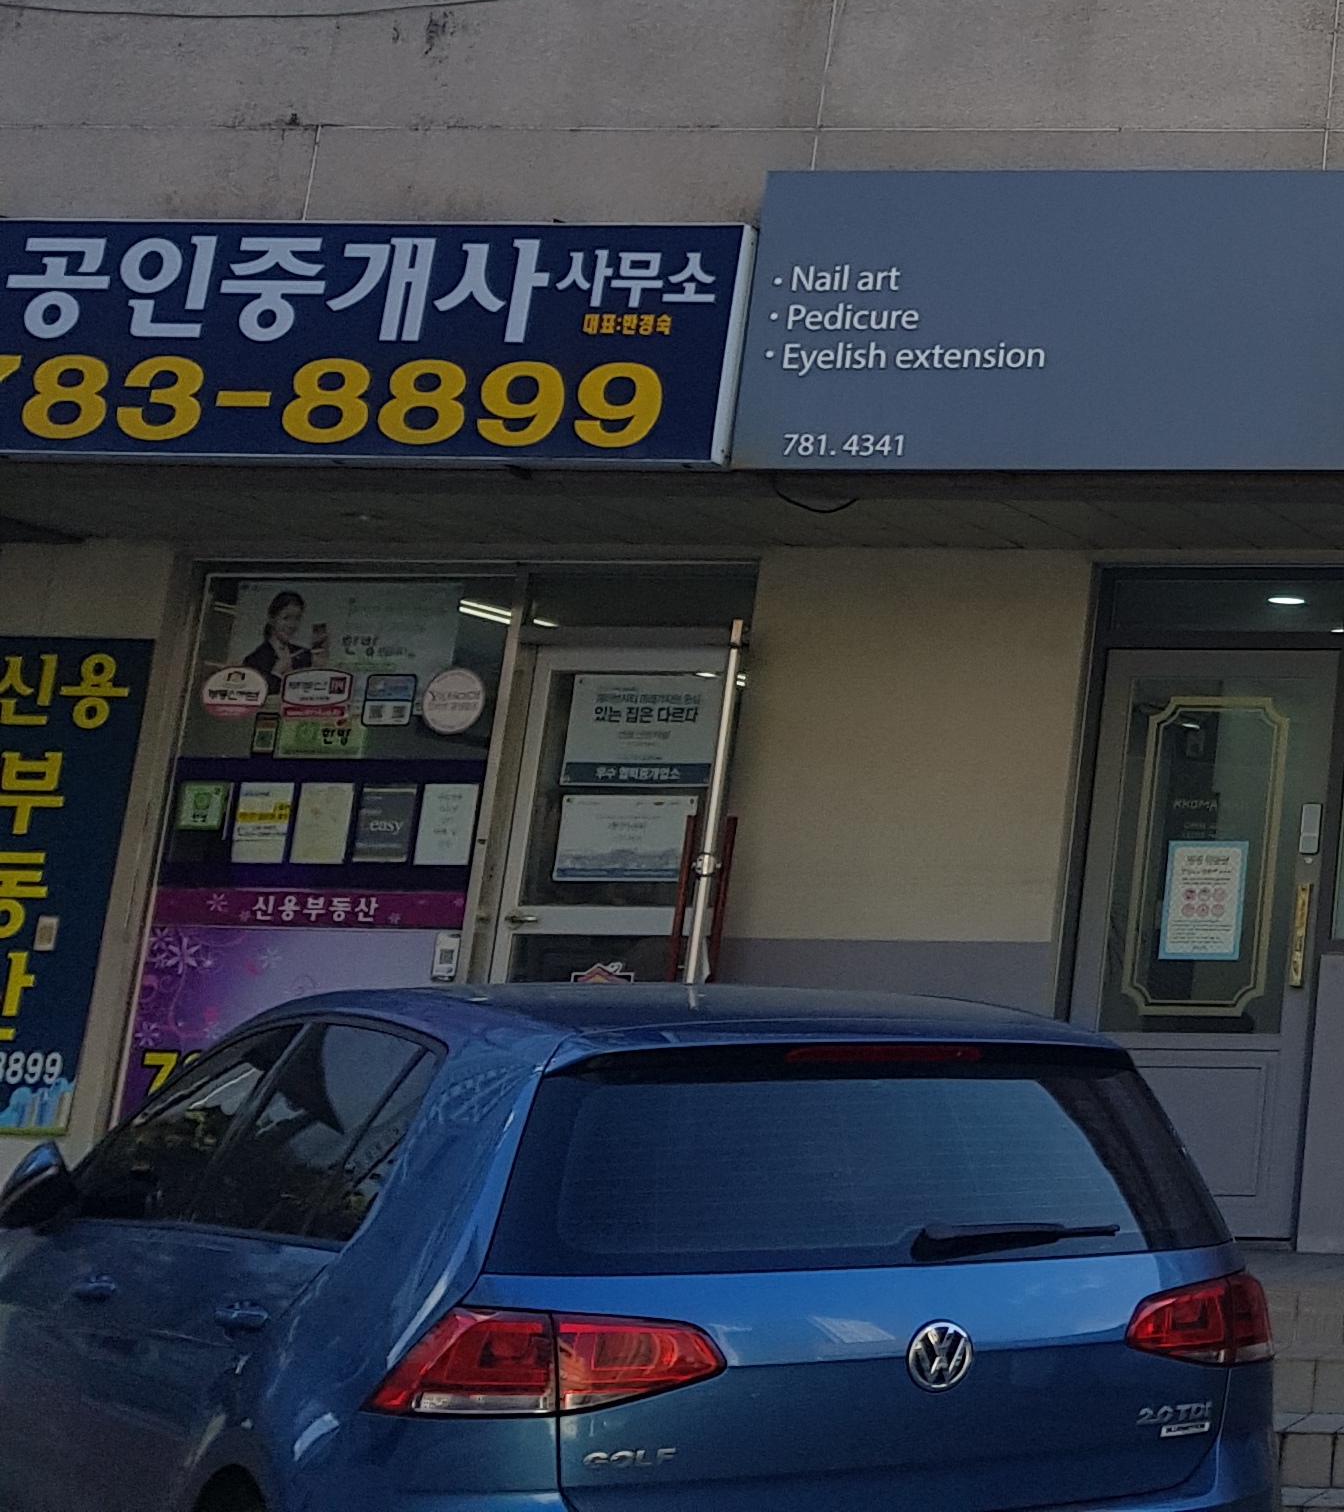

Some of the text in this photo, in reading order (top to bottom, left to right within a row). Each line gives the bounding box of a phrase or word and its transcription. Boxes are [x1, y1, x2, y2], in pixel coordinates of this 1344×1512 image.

[6, 235, 716, 343] 공인중개사 사무소
[790, 267, 900, 291] Nail art
[786, 305, 919, 330] Pedicure
[781, 343, 1046, 372] Eyelish extension
[783, 433, 906, 457] 781. 4341
[592, 705, 621, 724] 있는
[657, 707, 699, 723] 다르다
[252, 895, 379, 923] 신용부동산
[583, 1447, 677, 1470] GOLF
